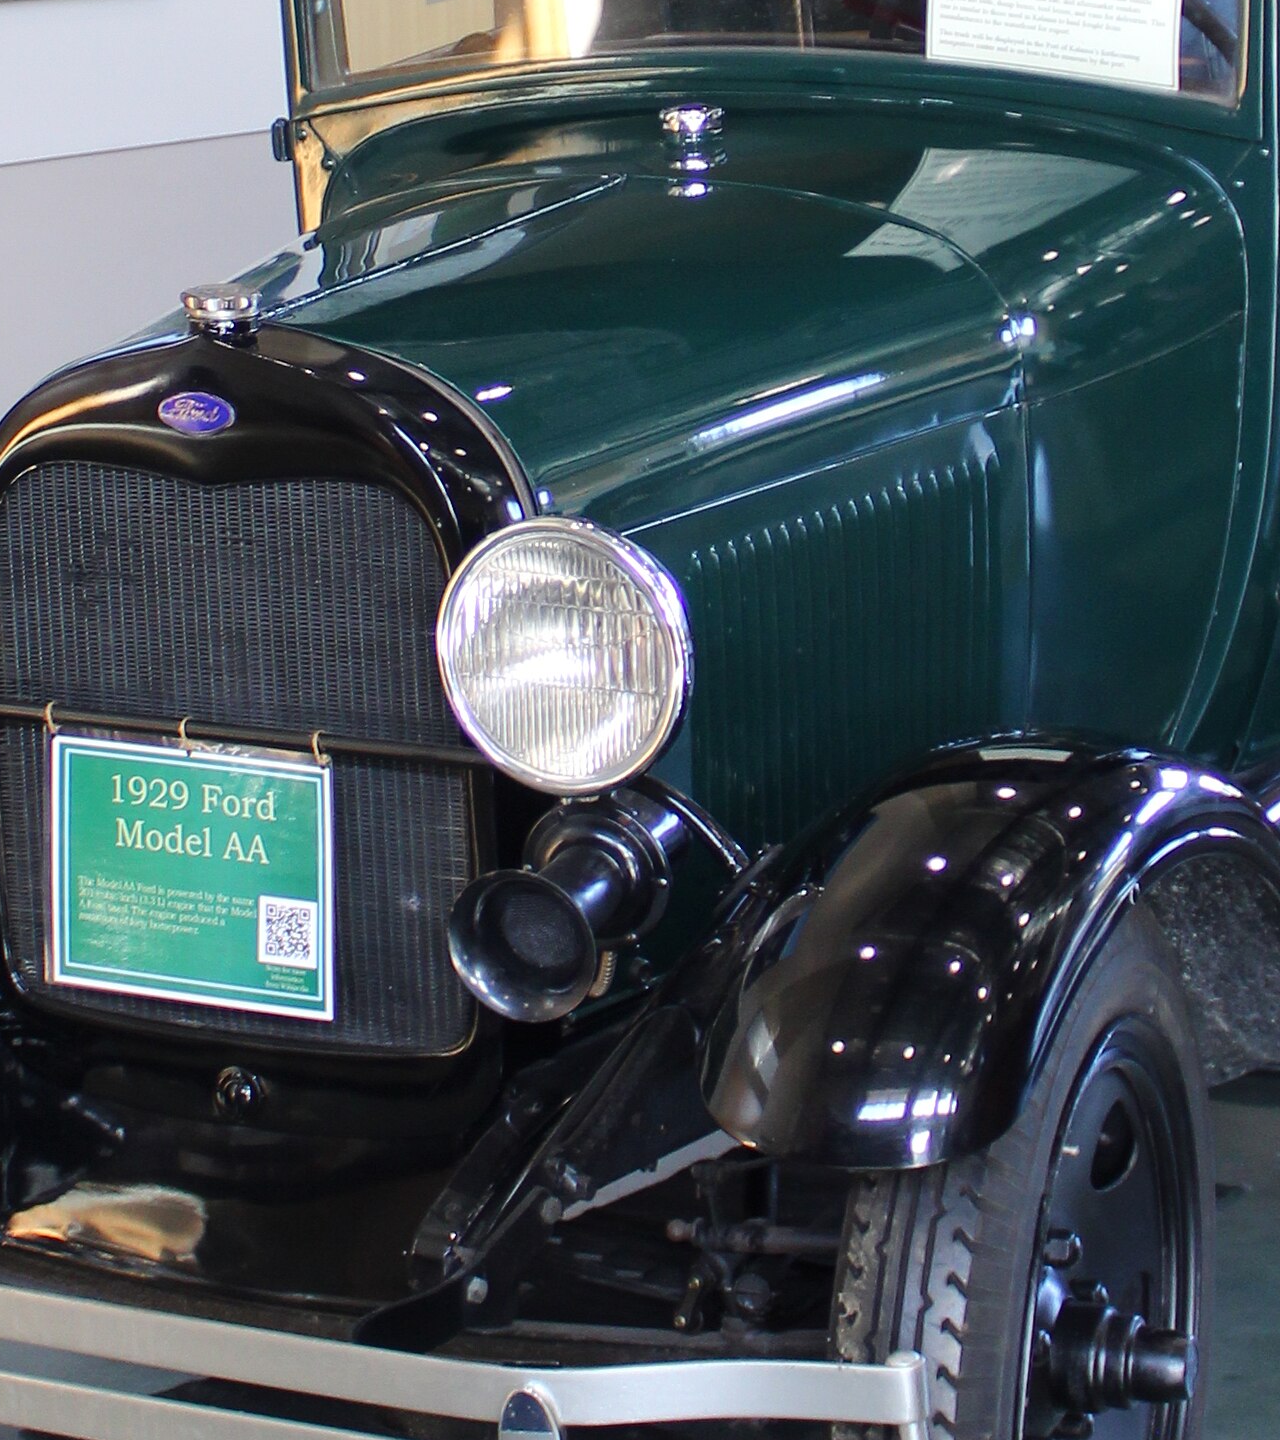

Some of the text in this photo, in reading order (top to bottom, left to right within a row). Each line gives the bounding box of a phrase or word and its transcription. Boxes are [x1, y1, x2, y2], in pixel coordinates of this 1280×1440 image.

[167, 399, 220, 423] Ford
[111, 774, 277, 822] 1929 Ford
[115, 817, 270, 865] Model AA
